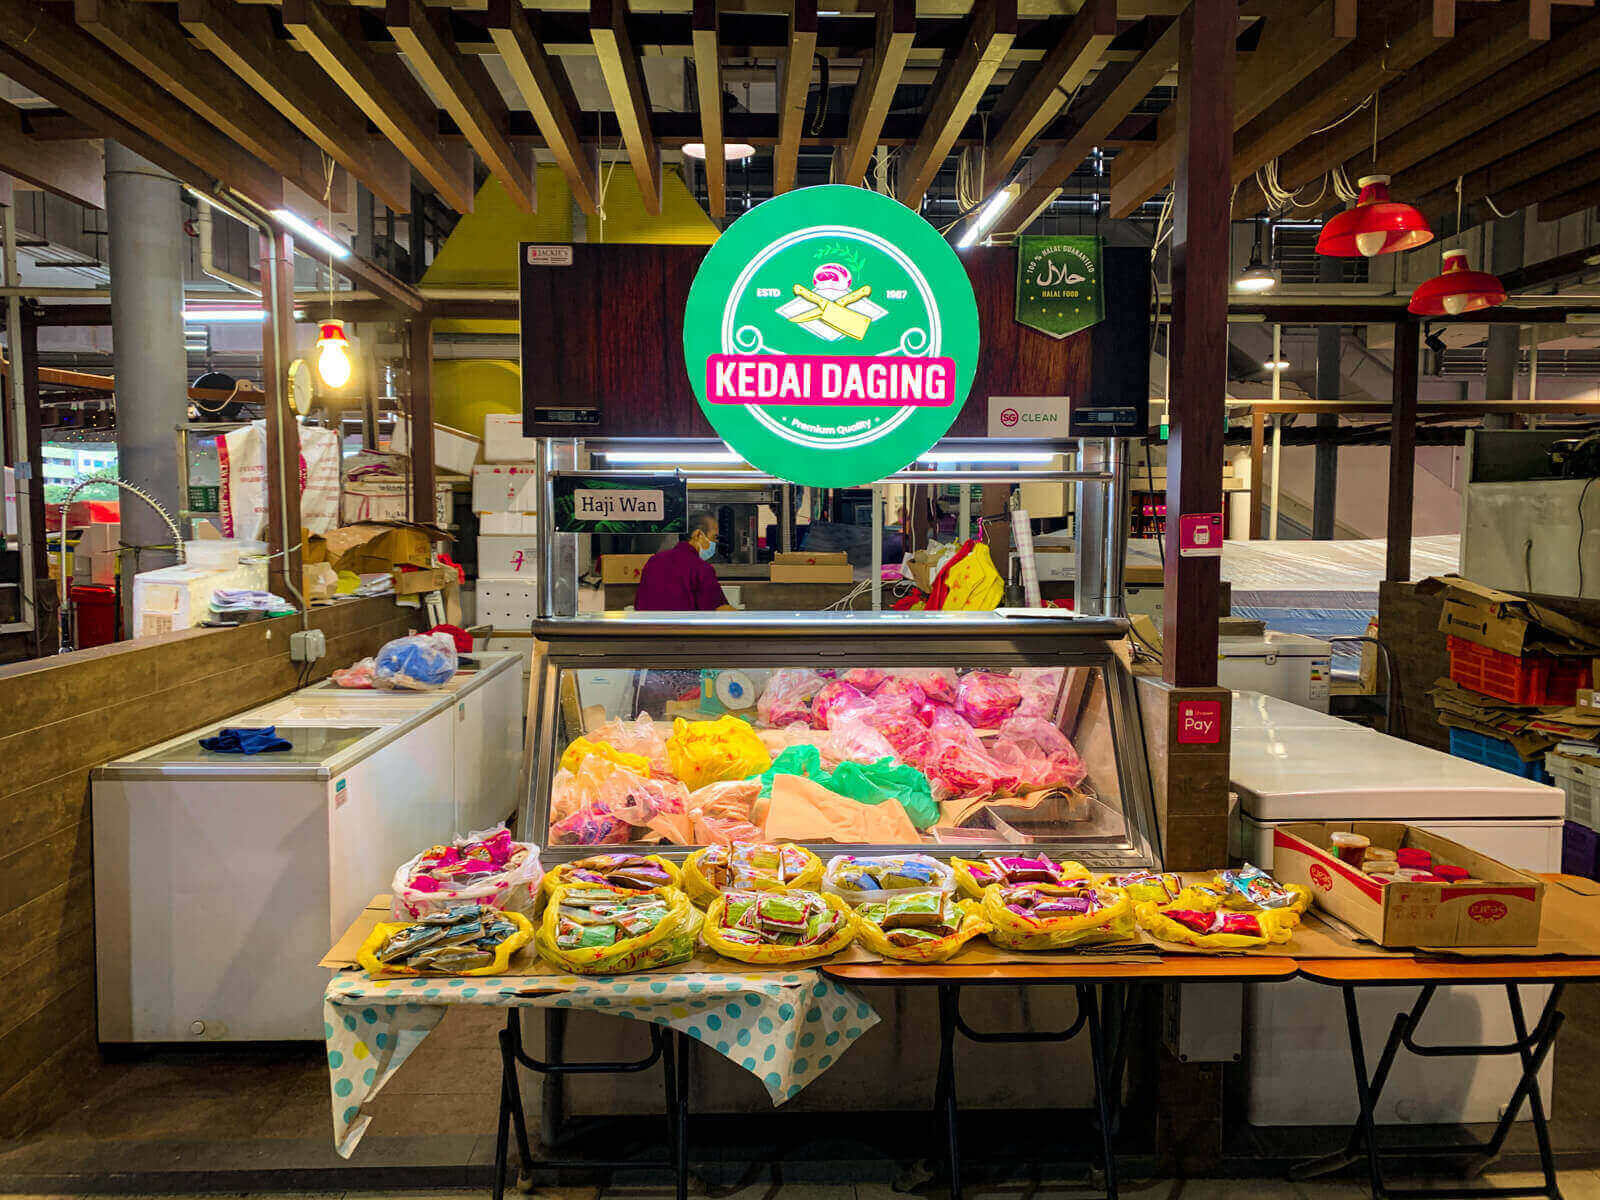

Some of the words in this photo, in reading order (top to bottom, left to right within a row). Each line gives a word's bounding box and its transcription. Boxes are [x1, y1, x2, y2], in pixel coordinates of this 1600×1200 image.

[1041, 246, 1061, 256] HALAL
[1036, 259, 1086, 286] حلال
[756, 288, 781, 298] ESTD
[1042, 290, 1060, 298] HALAL
[1063, 290, 1079, 298] FOOD
[715, 361, 811, 398] KEDAI
[821, 363, 946, 400] DAGING
[792, 417, 835, 434] Premium
[836, 419, 872, 435] Quality
[1021, 413, 1058, 422] CLEAN
[581, 496, 615, 517] Haji
[619, 497, 657, 512] Wan
[1184, 717, 1213, 734] Pay
